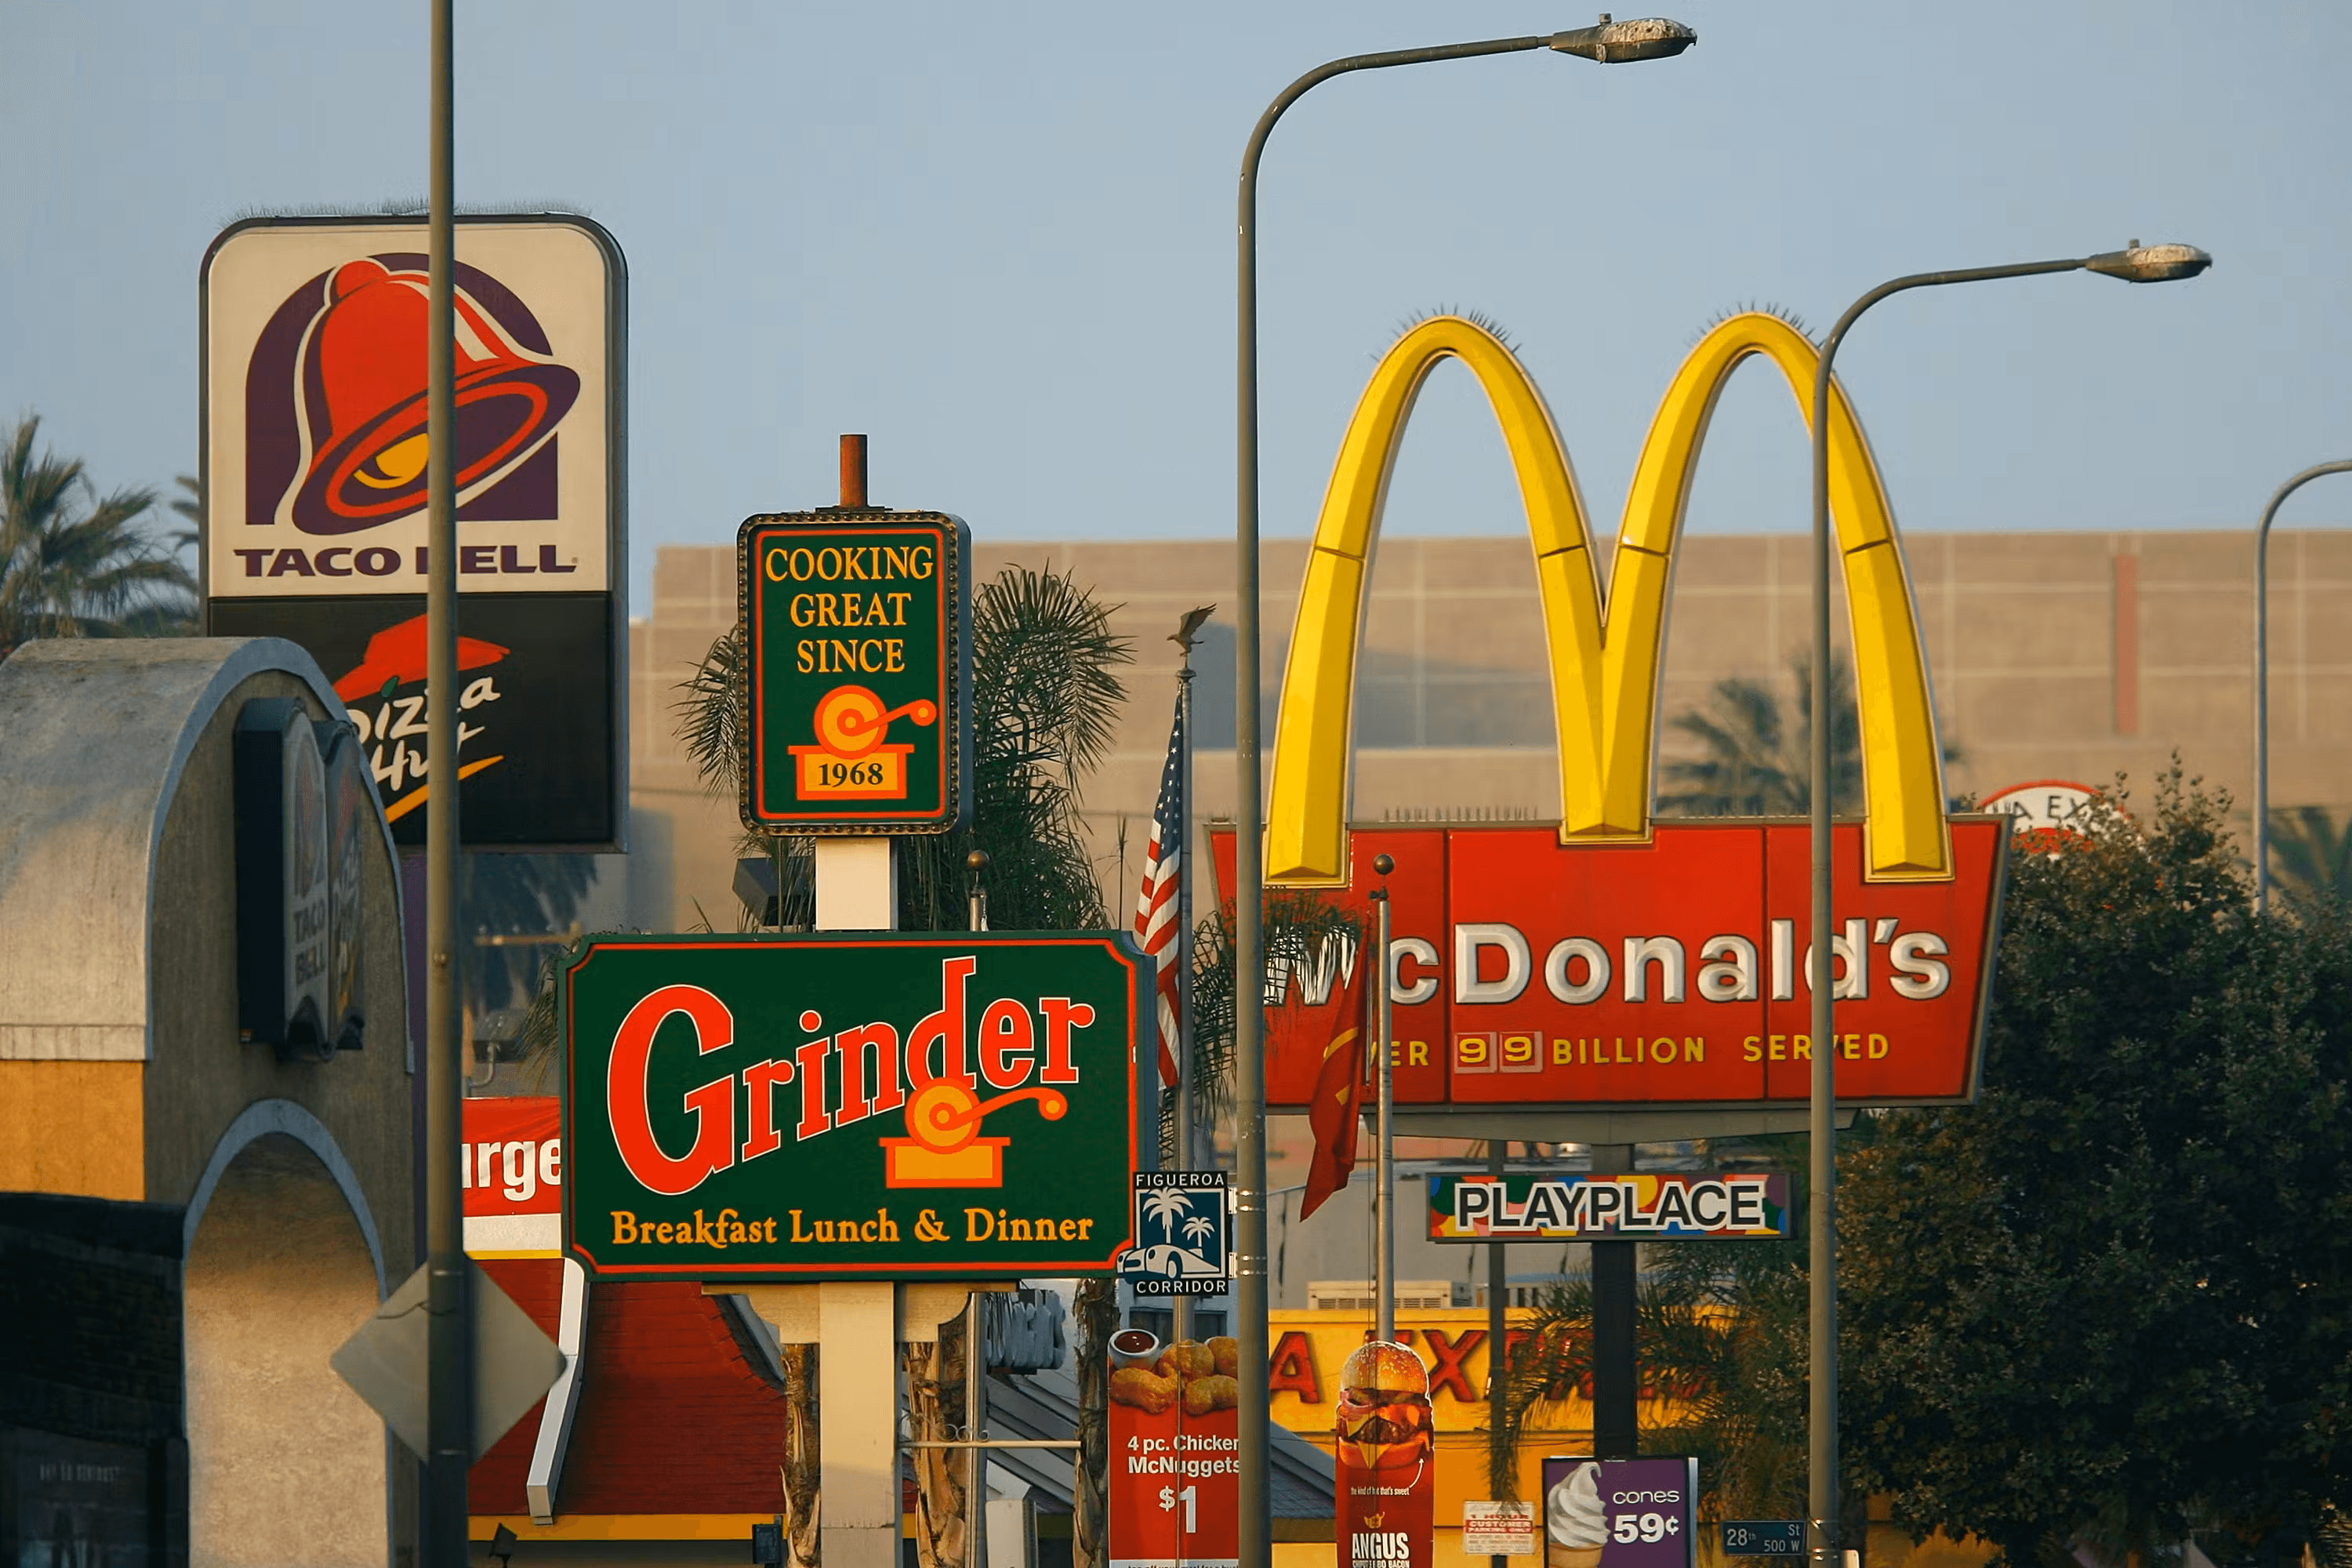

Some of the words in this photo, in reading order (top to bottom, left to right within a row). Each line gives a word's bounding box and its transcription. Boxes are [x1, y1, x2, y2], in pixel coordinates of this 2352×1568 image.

[234, 547, 401, 577] TACO
[765, 546, 933, 582] COOKING
[789, 592, 911, 628] GREAT
[797, 638, 905, 673] SINCE
[818, 761, 884, 787] 1968
[1458, 1036, 1533, 1065] 99
[1552, 1036, 1704, 1065] BILLION
[1743, 1033, 1889, 1062] SERED
[607, 955, 1095, 1196] Grinder
[1136, 1173, 1225, 1187] FIGUEROA
[1457, 1183, 1764, 1229] PLAYPLACE
[610, 1208, 778, 1250] Breakfast
[789, 1209, 901, 1243] Lunch
[914, 1210, 951, 1242] &
[964, 1209, 1094, 1243] Dinner
[1136, 1279, 1226, 1294] CORRIDOR
[1127, 1436, 1139, 1451] 4
[1142, 1439, 1171, 1455] pc.
[1159, 1485, 1197, 1534] $1
[1613, 1490, 1680, 1504] cones
[1613, 1512, 1680, 1544] 59¢
[1726, 1528, 1756, 1546] 28th
[1788, 1523, 1800, 1537] St
[1352, 1532, 1410, 1560] ANGUS
[1763, 1539, 1786, 1552] 500
[1791, 1539, 1800, 1552] W
